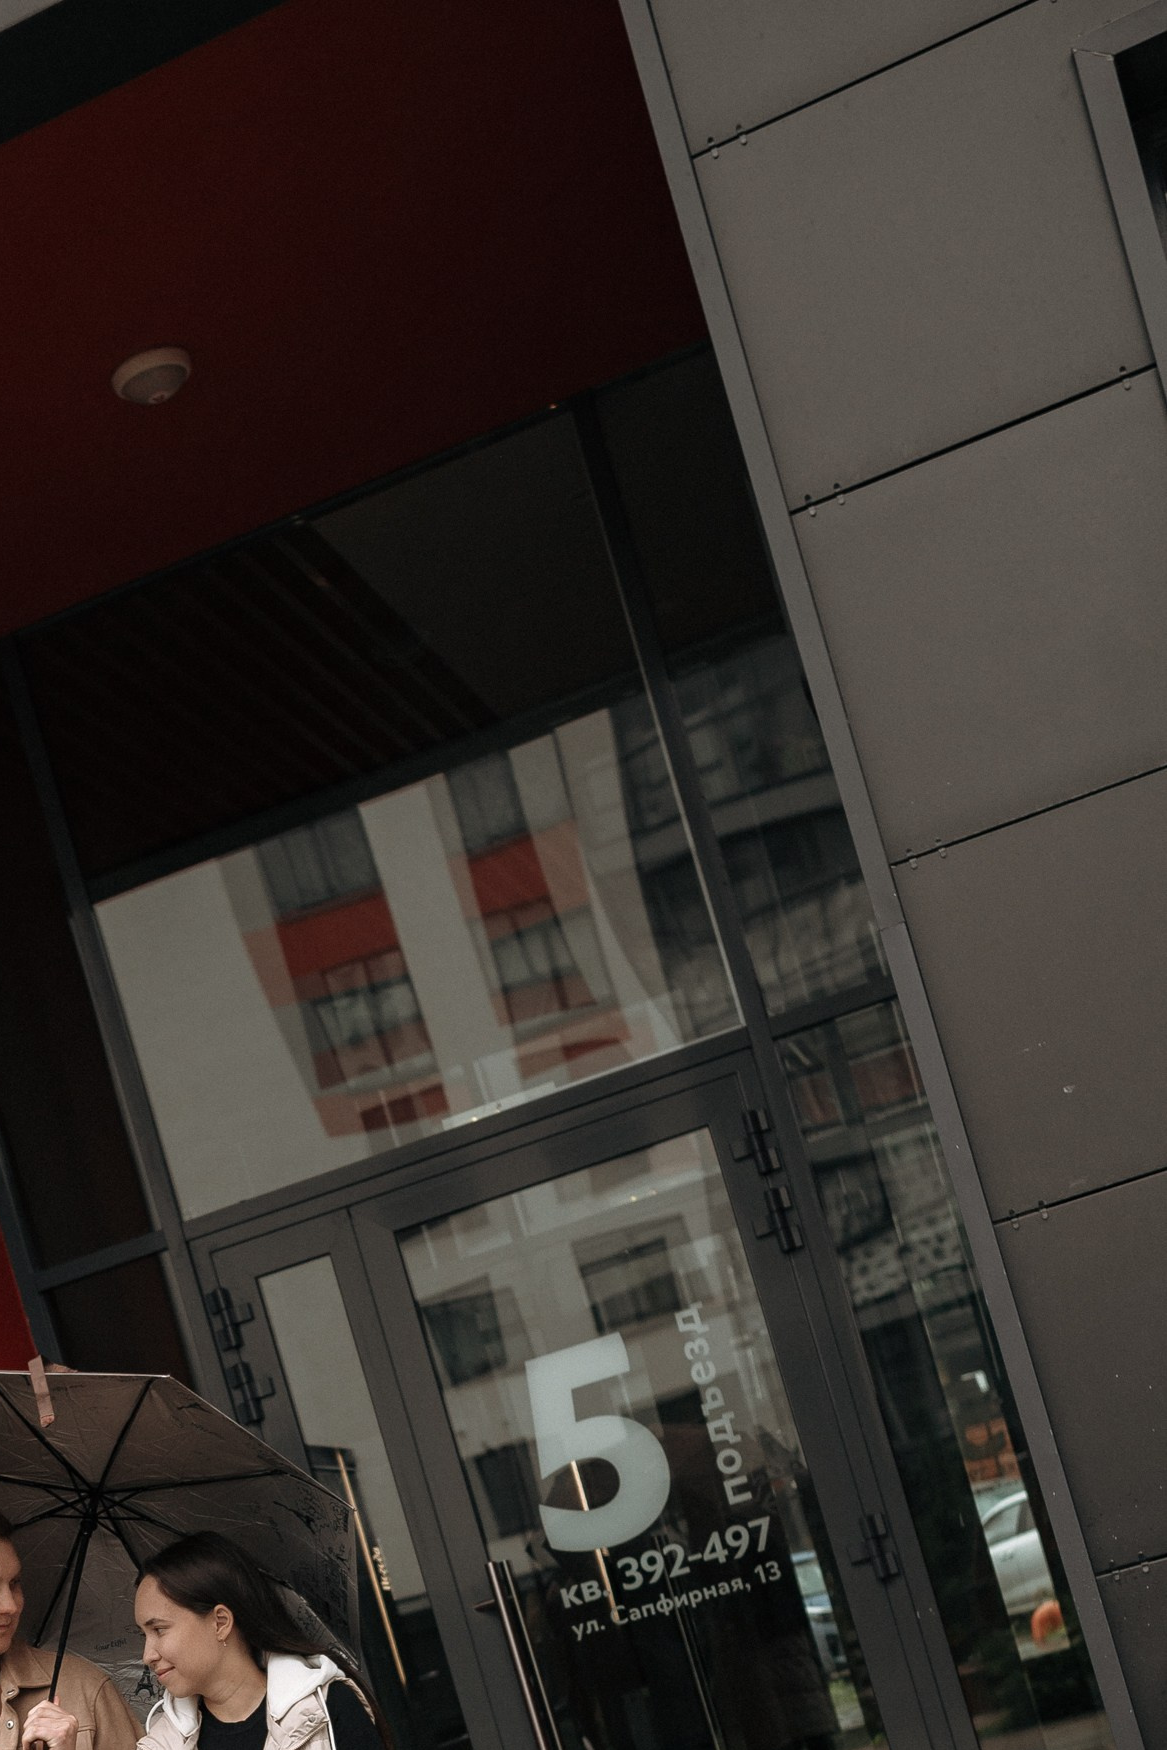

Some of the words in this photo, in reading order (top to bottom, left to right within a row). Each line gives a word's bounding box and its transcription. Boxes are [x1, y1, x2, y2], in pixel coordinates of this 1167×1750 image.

[524, 1331, 671, 1552] 5
[675, 1301, 753, 1506] подъезд
[559, 1578, 612, 1609] кв.
[616, 1516, 772, 1592] 392-497
[571, 1618, 606, 1641] ул.
[611, 1579, 752, 1626] Сапфирная,
[754, 1560, 783, 1585] 13
